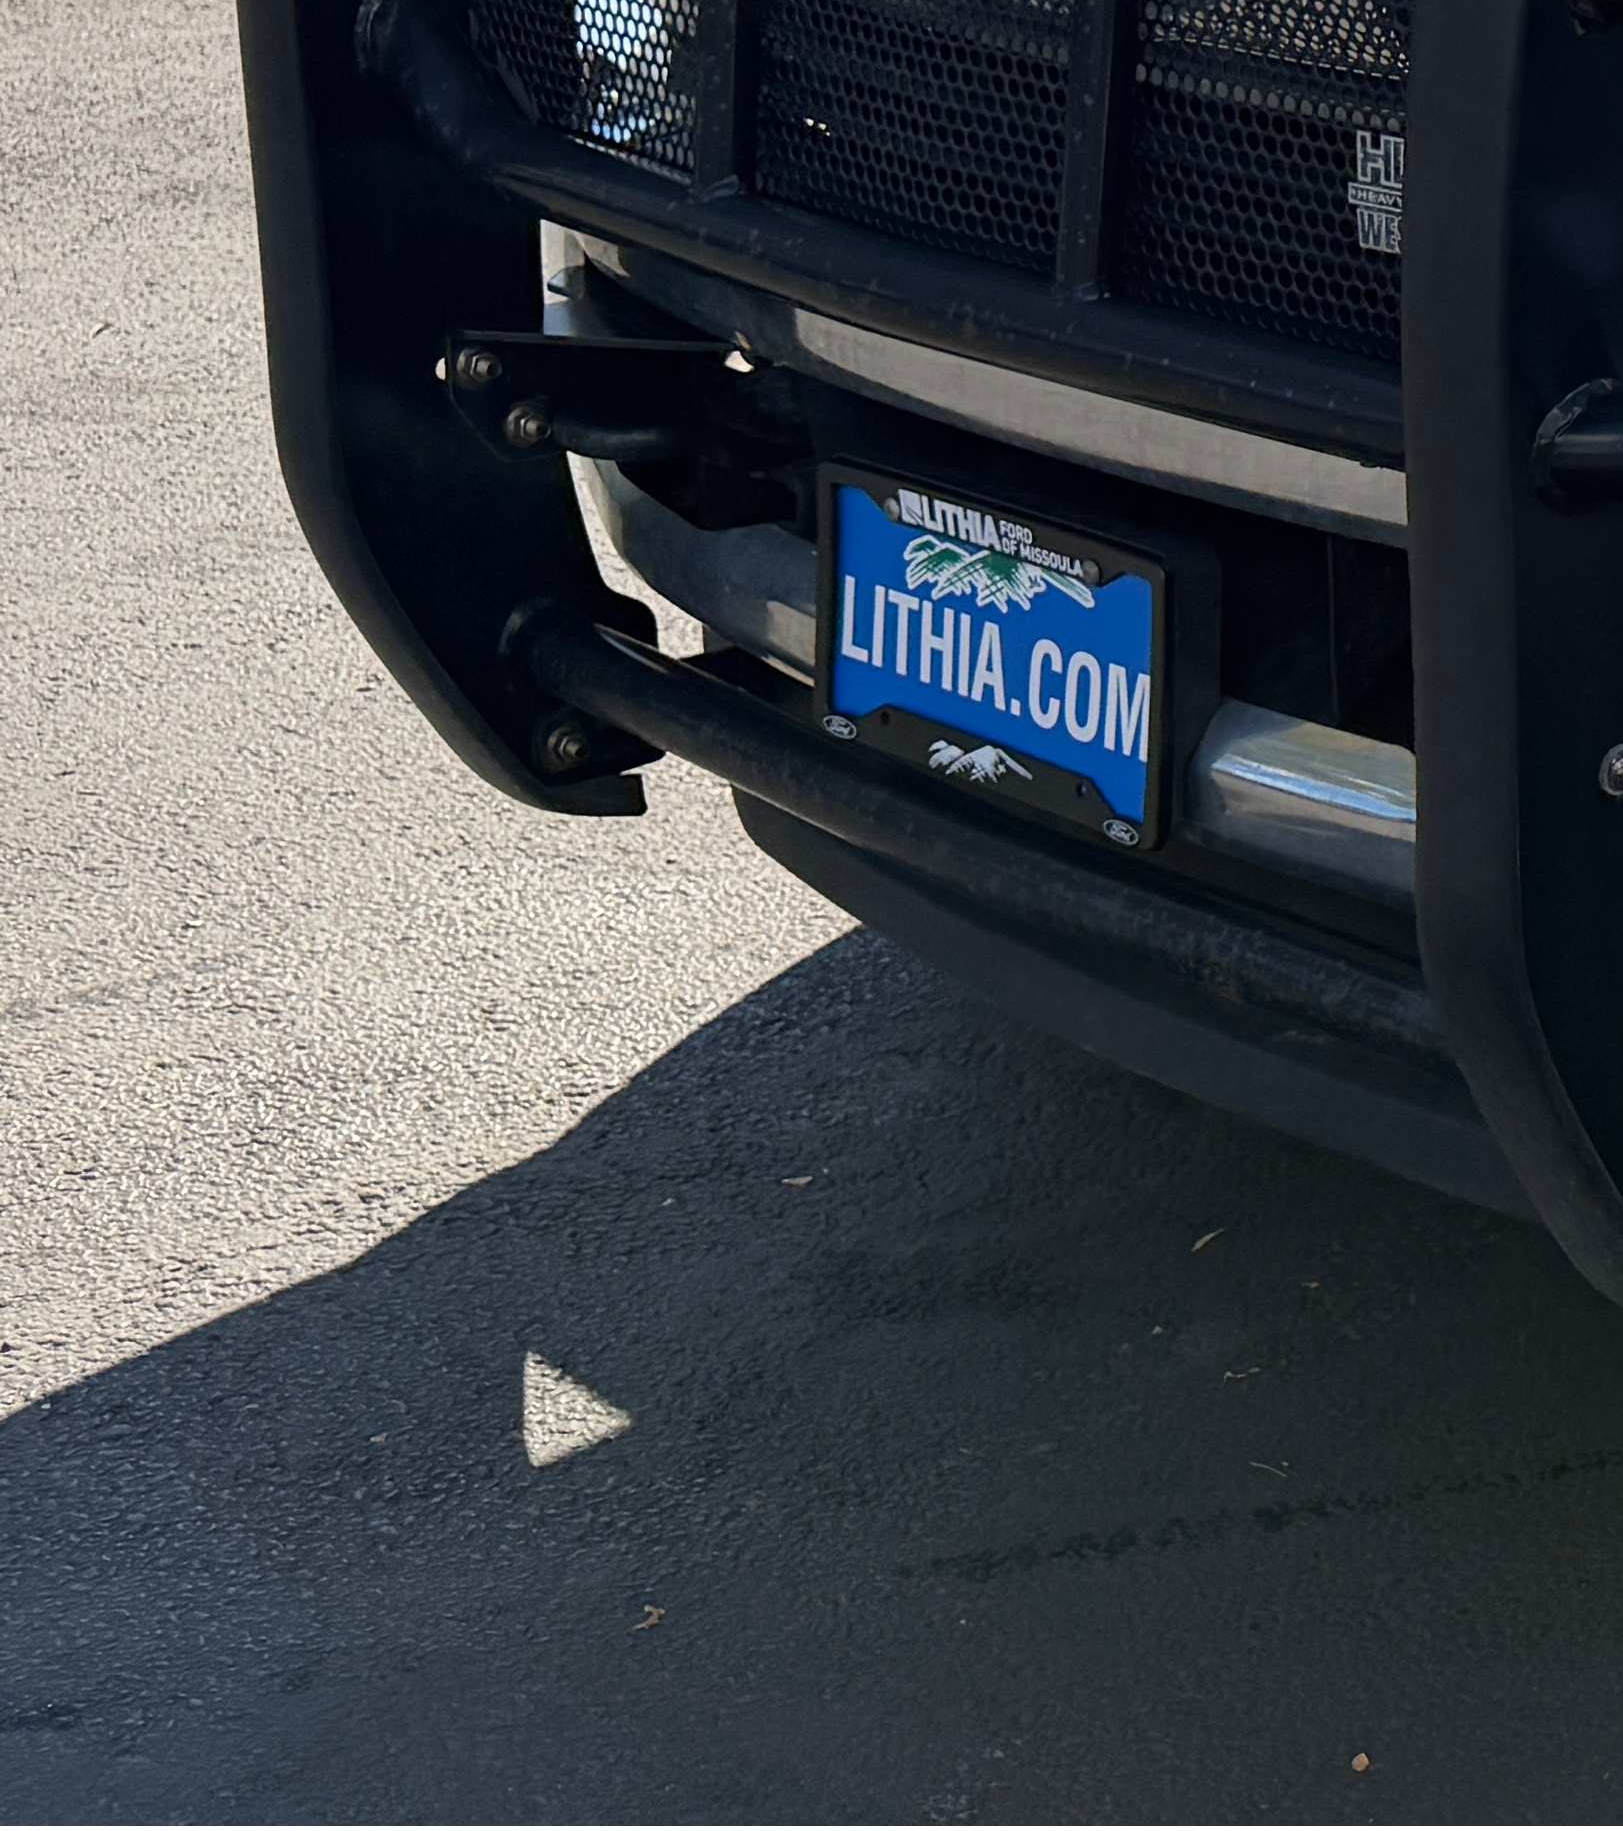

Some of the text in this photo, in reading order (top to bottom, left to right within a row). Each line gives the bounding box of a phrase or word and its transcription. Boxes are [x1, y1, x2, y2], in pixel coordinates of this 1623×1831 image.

[921, 493, 1033, 553] LITHIA FORD
[1002, 537, 1084, 578] OF MISSOULA
[841, 575, 1152, 763] LITHIA.COM
